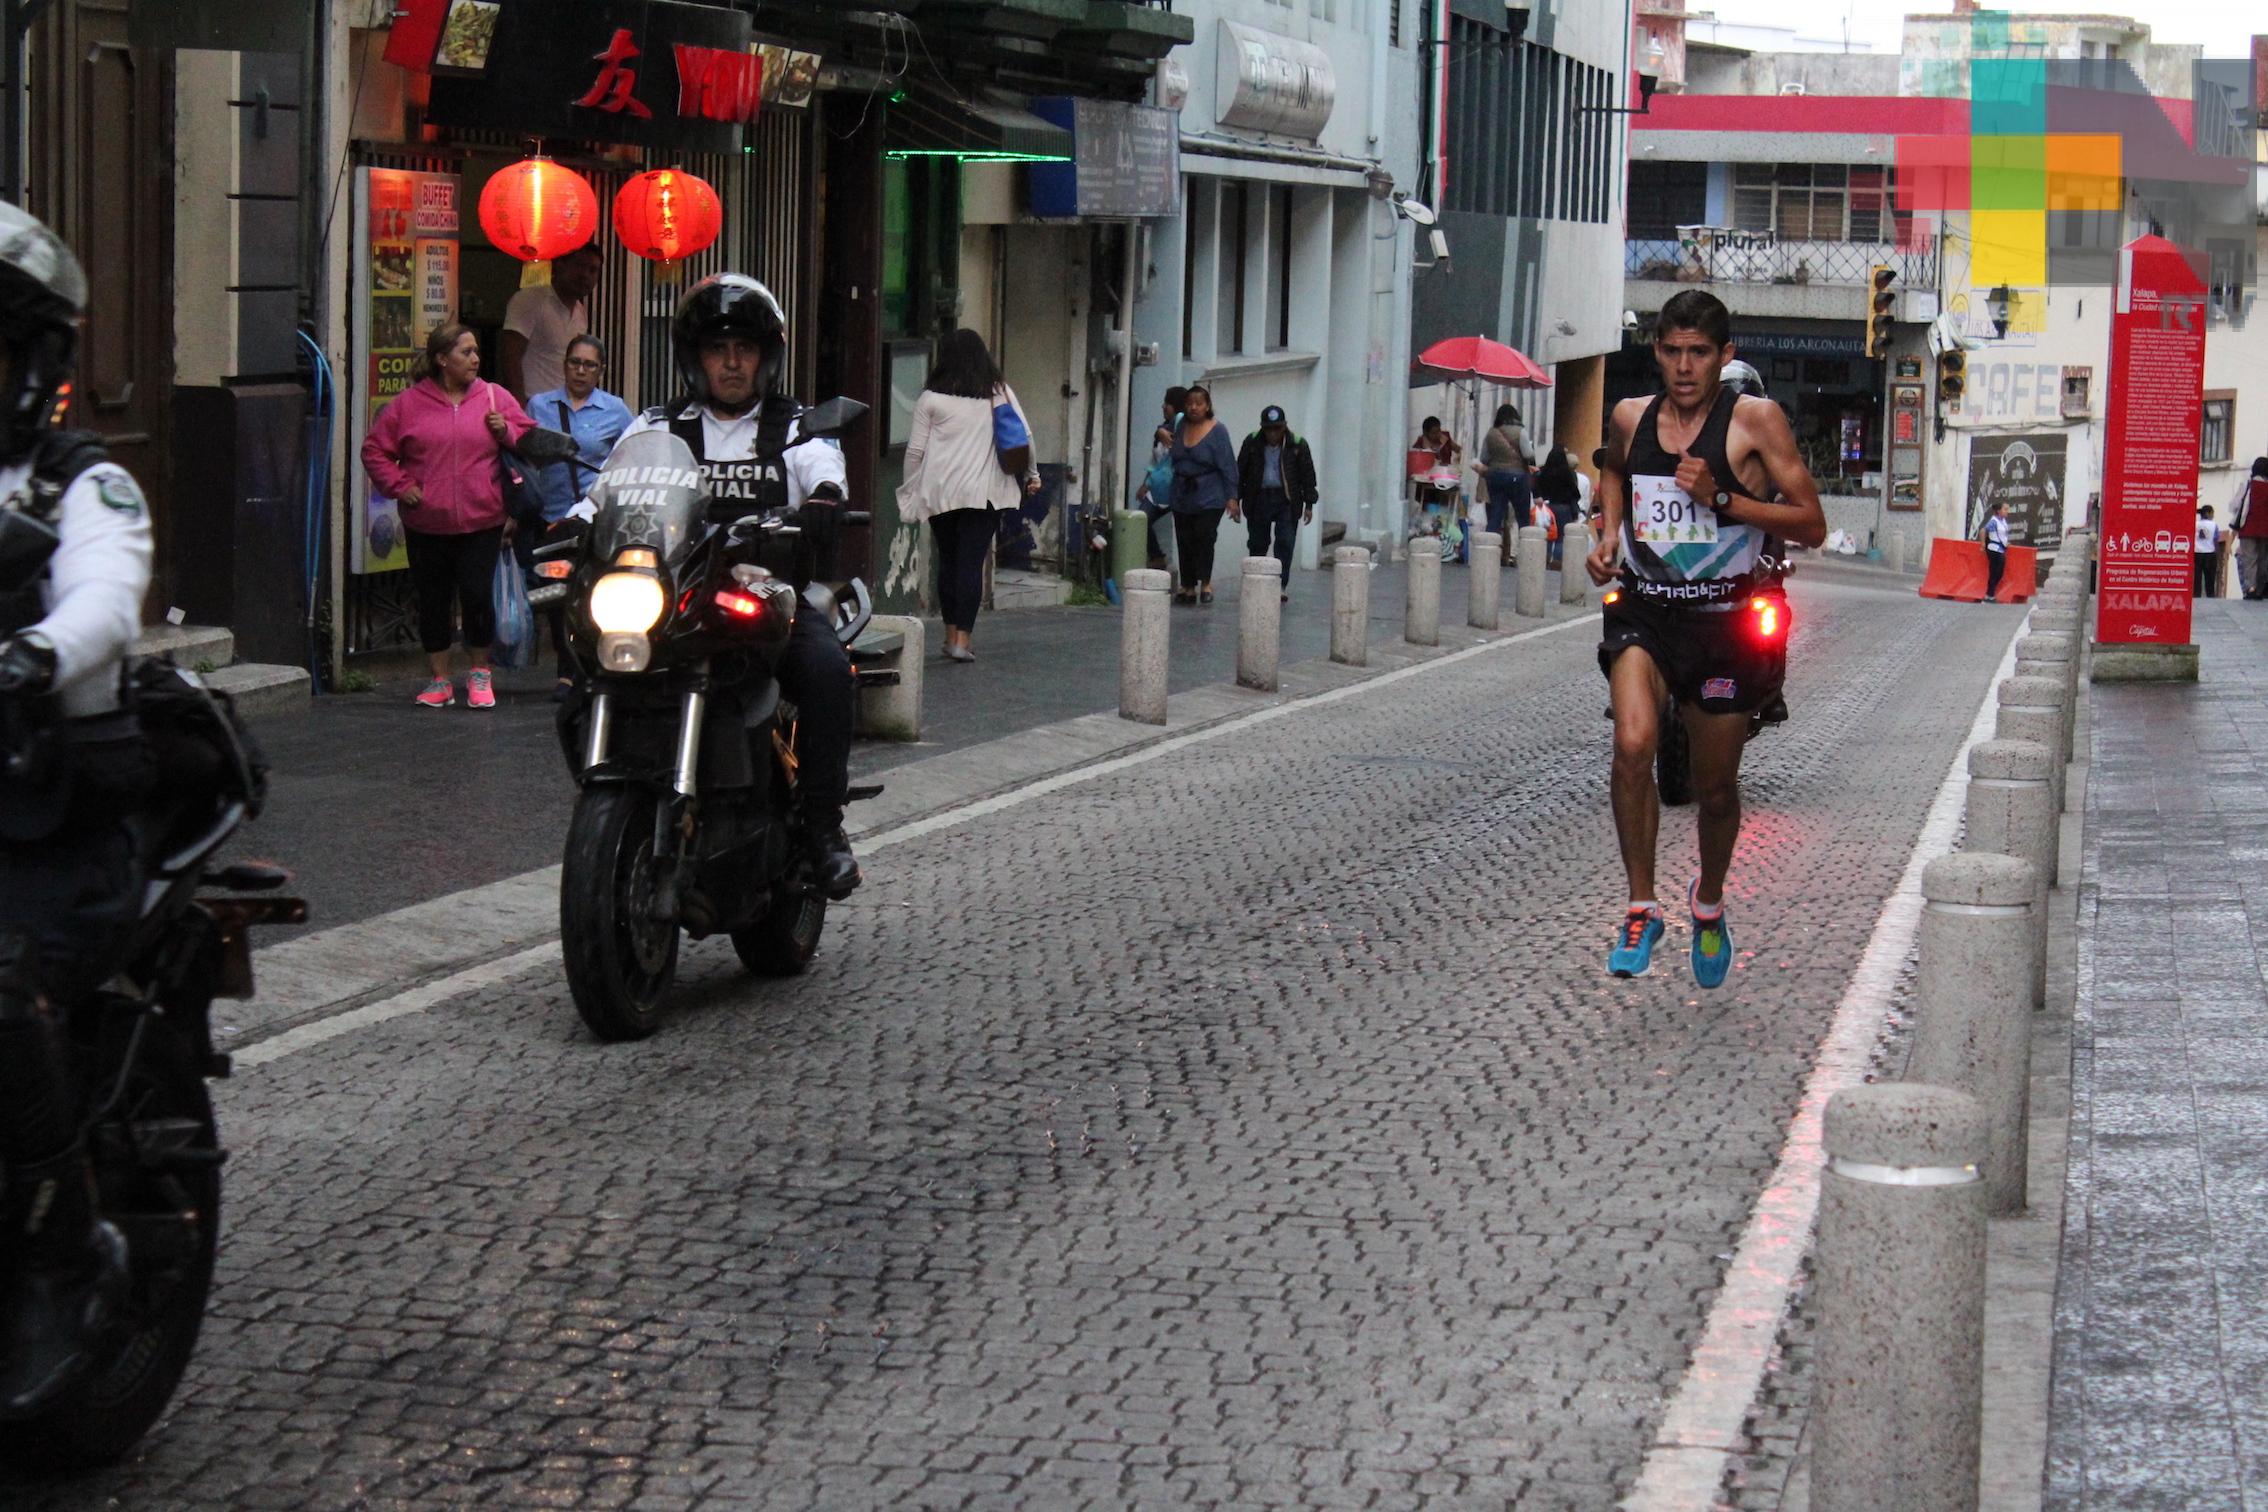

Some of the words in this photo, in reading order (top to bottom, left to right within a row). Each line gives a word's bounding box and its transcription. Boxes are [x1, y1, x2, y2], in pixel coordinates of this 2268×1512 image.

[423, 184, 453, 206] BUFFET
[417, 212, 438, 227] COMIDA
[440, 213, 456, 228] CHINA
[1715, 230, 1774, 252] plural
[1778, 337, 1795, 349] LOS
[1797, 337, 1866, 352] ARGONAUTA
[379, 378, 406, 393] PARA
[1964, 363, 2058, 416] CAFE
[596, 466, 699, 490] POLICIA
[617, 488, 669, 507] VIAL
[1652, 500, 1697, 523] 301
[2104, 593, 2186, 612] XALAPA
